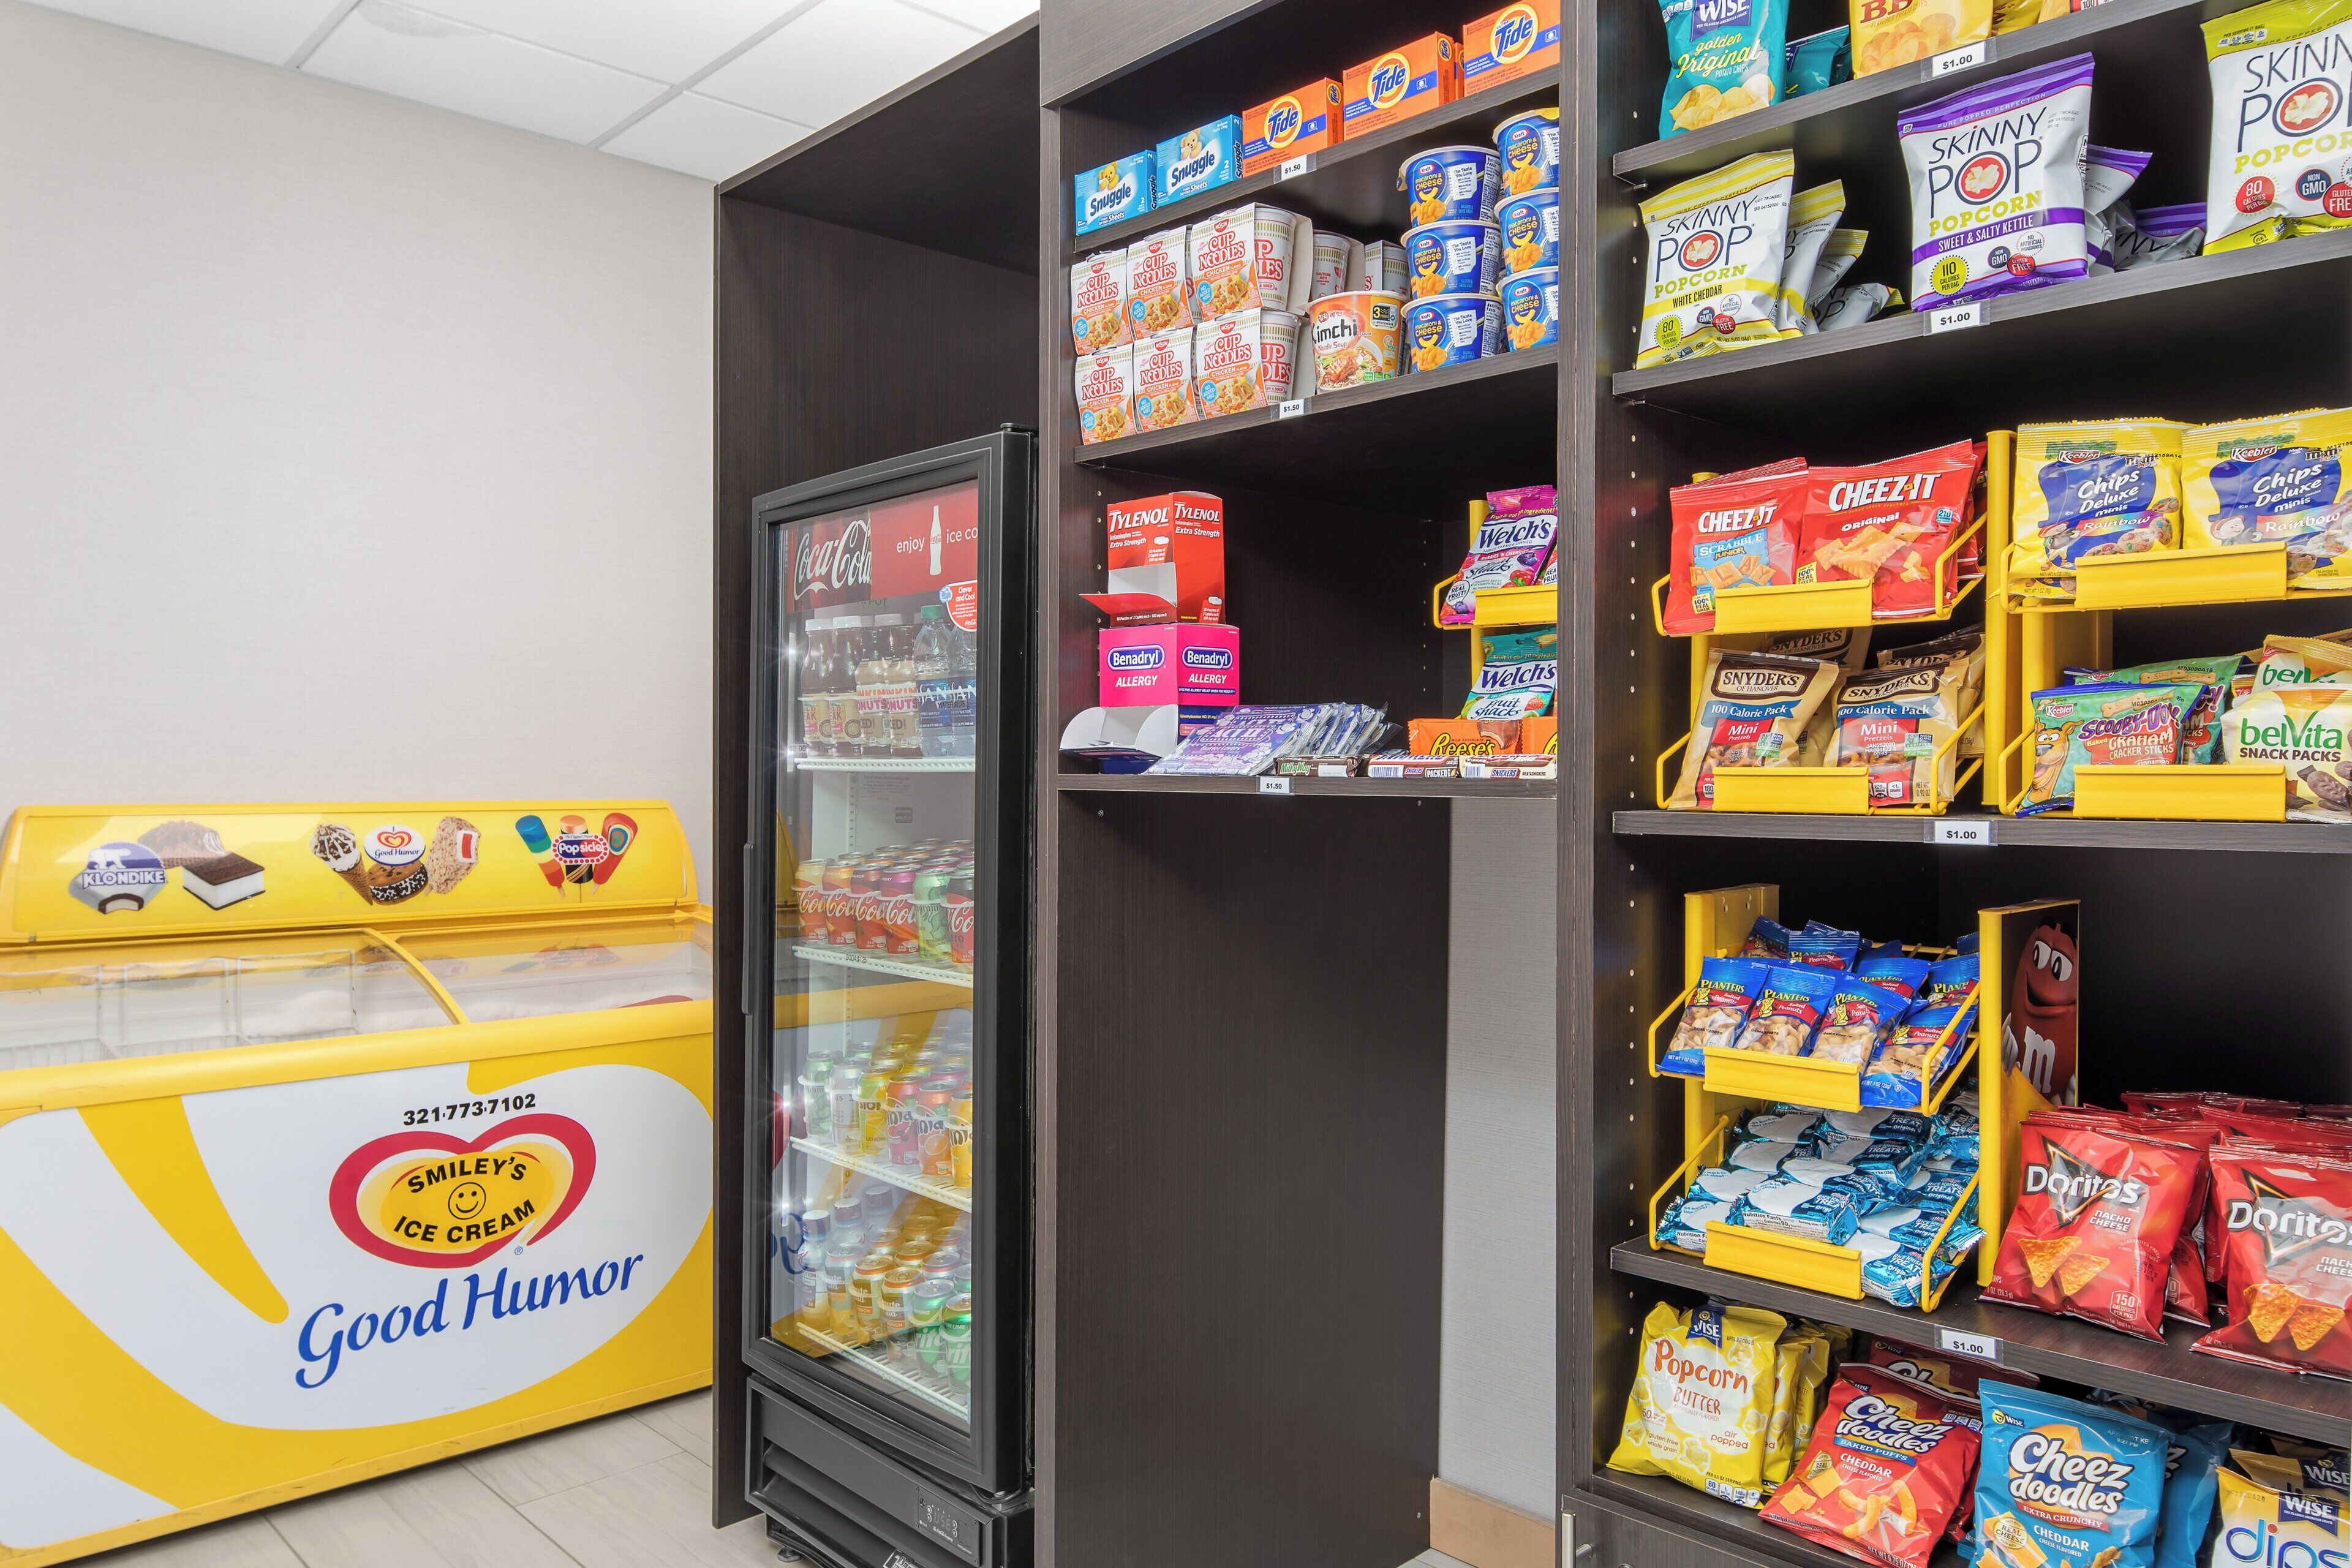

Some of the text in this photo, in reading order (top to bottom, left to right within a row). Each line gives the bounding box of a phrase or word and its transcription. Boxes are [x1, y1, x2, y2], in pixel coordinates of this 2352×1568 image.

[1495, 15, 1533, 59] Tide
[1695, 33, 1743, 52] golden
[1715, 65, 1748, 77] POTATO CHIPS
[1943, 55, 1972, 70] $1.00
[1960, 110, 1991, 124] POPPED
[1994, 92, 2046, 114] PERFECTION
[1268, 106, 1298, 143] Tide
[1929, 106, 2048, 164] SKINNY
[1171, 151, 1215, 187] Snuggle
[1284, 164, 1300, 174] $1.50
[1191, 181, 1207, 192] Sheets
[1415, 173, 1436, 184] macaroni
[1928, 138, 2042, 219] POP
[1929, 190, 2043, 237] POPCORN
[1215, 221, 1229, 230] NISSIN
[1938, 215, 2034, 252] SWEET & SALTY KETTLE
[1208, 231, 1235, 249] CUP
[1199, 244, 1245, 270] NOODLES
[1207, 266, 1230, 276] CHICKEN
[1942, 262, 1957, 276] 110
[2011, 262, 2030, 272] FREE
[1940, 274, 1959, 285] CALORIES
[1673, 285, 1722, 308] WHITE CHEDDAR
[1373, 308, 1379, 318] 3
[1940, 312, 1970, 325] $1.00
[1663, 320, 1673, 331] 80
[2232, 447, 2275, 461] Keebler
[2253, 464, 2323, 493] Chips
[2255, 481, 2322, 508] Deluxe
[2274, 496, 2311, 513] minis
[1109, 507, 1169, 532] TYLENOL
[2265, 513, 2340, 532] Rainbow
[947, 530, 962, 543] ice
[1479, 519, 1551, 549] Welch's
[897, 537, 925, 553] enjoy
[1110, 538, 1146, 548] Extra Strength
[1700, 533, 1763, 557] SCRABBLE
[1714, 547, 1746, 559] JUNIOR
[1449, 590, 1466, 600] FRUIT!
[1113, 650, 1158, 665] Benadryl
[1116, 676, 1158, 687] ALLERGY
[1723, 671, 1800, 687] SNYDER'S
[1710, 704, 1787, 718] 100 Calorie Pack
[1728, 723, 1757, 735] Mini
[1430, 733, 1495, 755] Reese's
[2109, 728, 2173, 750] GRAHAM
[2109, 744, 2174, 761] CRACKER STICKS
[2239, 747, 2341, 762] SNACK PACKS
[1947, 830, 1977, 840] $1.00
[374, 848, 420, 858] Good Humor
[82, 869, 165, 887] KLONDIKE
[1765, 989, 1810, 1001] PLANTERS
[407, 1156, 526, 1194] SMILEY'S
[2026, 1166, 2142, 1204] Doritos
[393, 1200, 535, 1243] ICE CREAM
[2090, 1215, 2130, 1231] CHEESE
[2113, 1303, 2135, 1314] CALORIES
[2116, 1293, 2135, 1307] 150
[295, 1254, 643, 1389] Good Humor
[1953, 1340, 1983, 1352] $1.00
[1655, 1340, 1747, 1393] Popcorn
[1673, 1386, 1722, 1415] BUTTER
[1845, 1395, 1950, 1441] Cheez
[2005, 1416, 2022, 1427] WISE
[1649, 1433, 1665, 1441] gluten
[1710, 1434, 1748, 1450] popped
[1838, 1418, 1937, 1452] doodles
[1839, 1441, 1907, 1461] BAKED PUFFS
[1840, 1453, 1892, 1477] CHEDDAR
[2010, 1434, 2133, 1490] Cheez
[2010, 1475, 2124, 1513] doodles
[2286, 1494, 2335, 1518] WISE
[2024, 1506, 2102, 1528] EXTRA CRUNCHY
[2034, 1525, 2089, 1551] CHEDDAR
